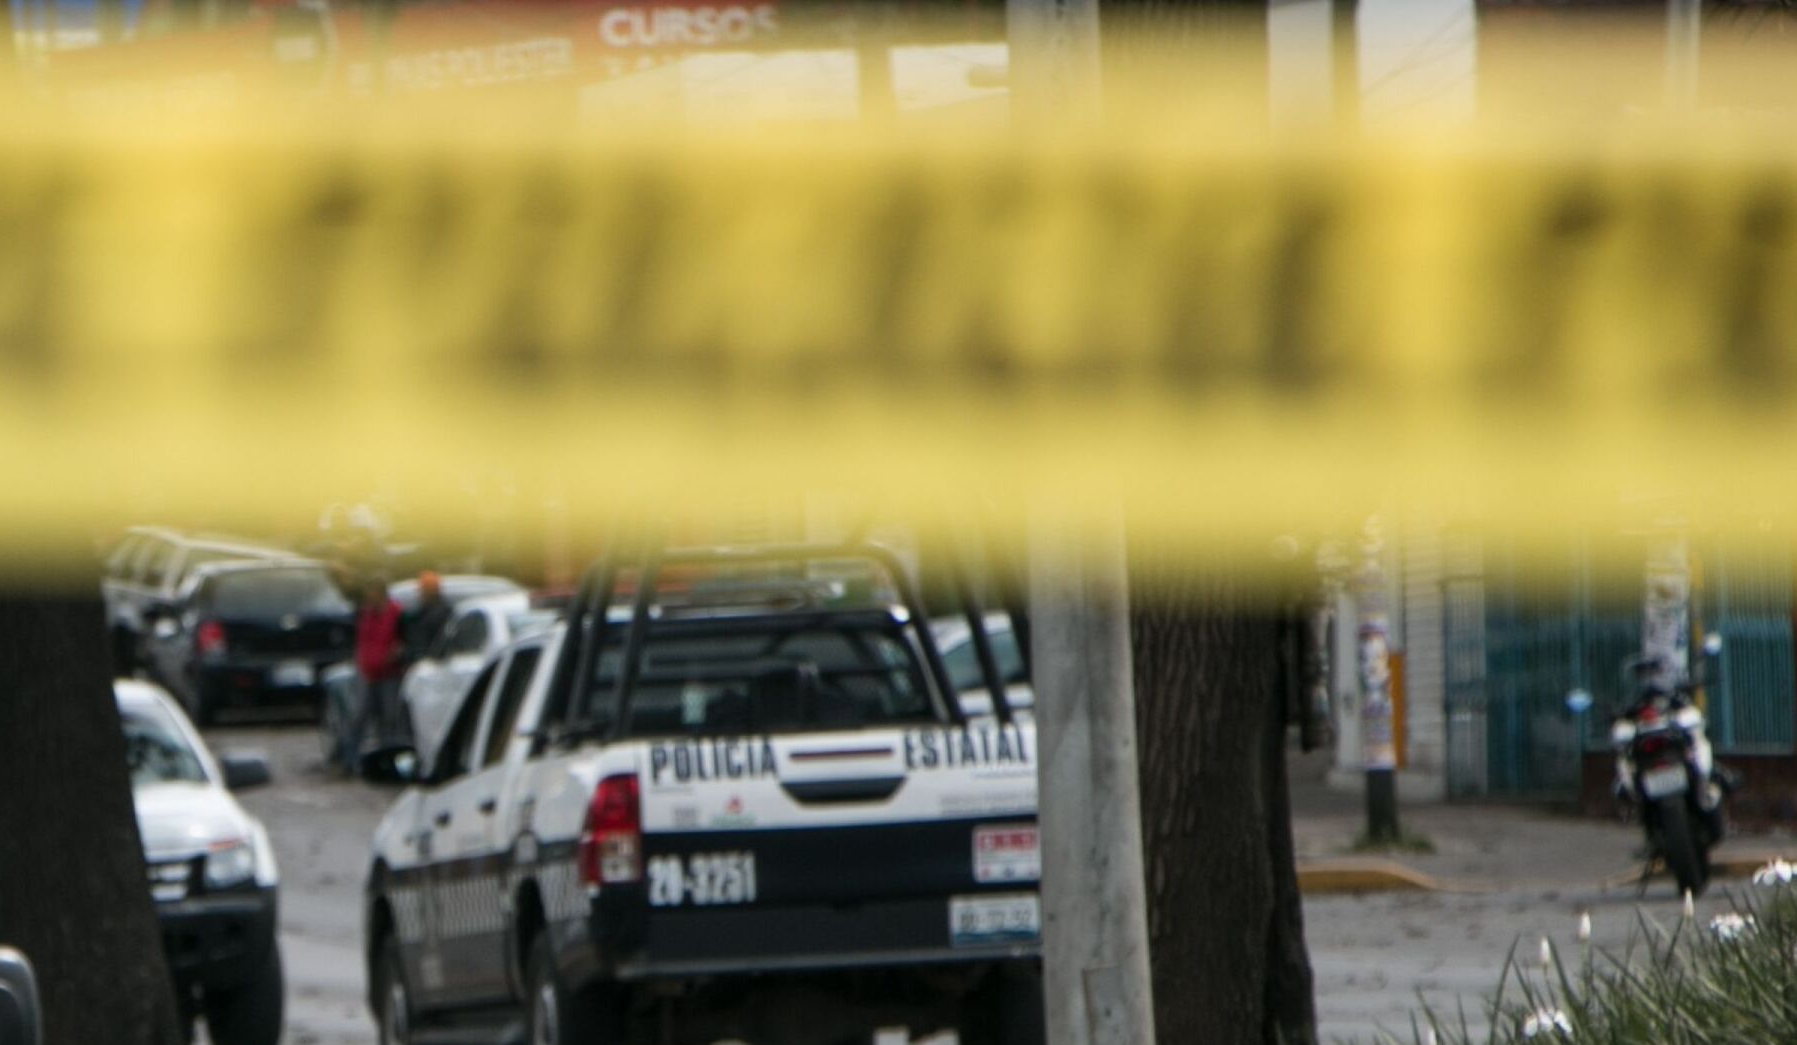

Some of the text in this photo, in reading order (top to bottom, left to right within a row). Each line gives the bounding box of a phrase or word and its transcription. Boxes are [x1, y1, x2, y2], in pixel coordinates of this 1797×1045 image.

[599, 5, 778, 47] CURSOS
[650, 726, 1027, 784] POLICIA ESTATAL
